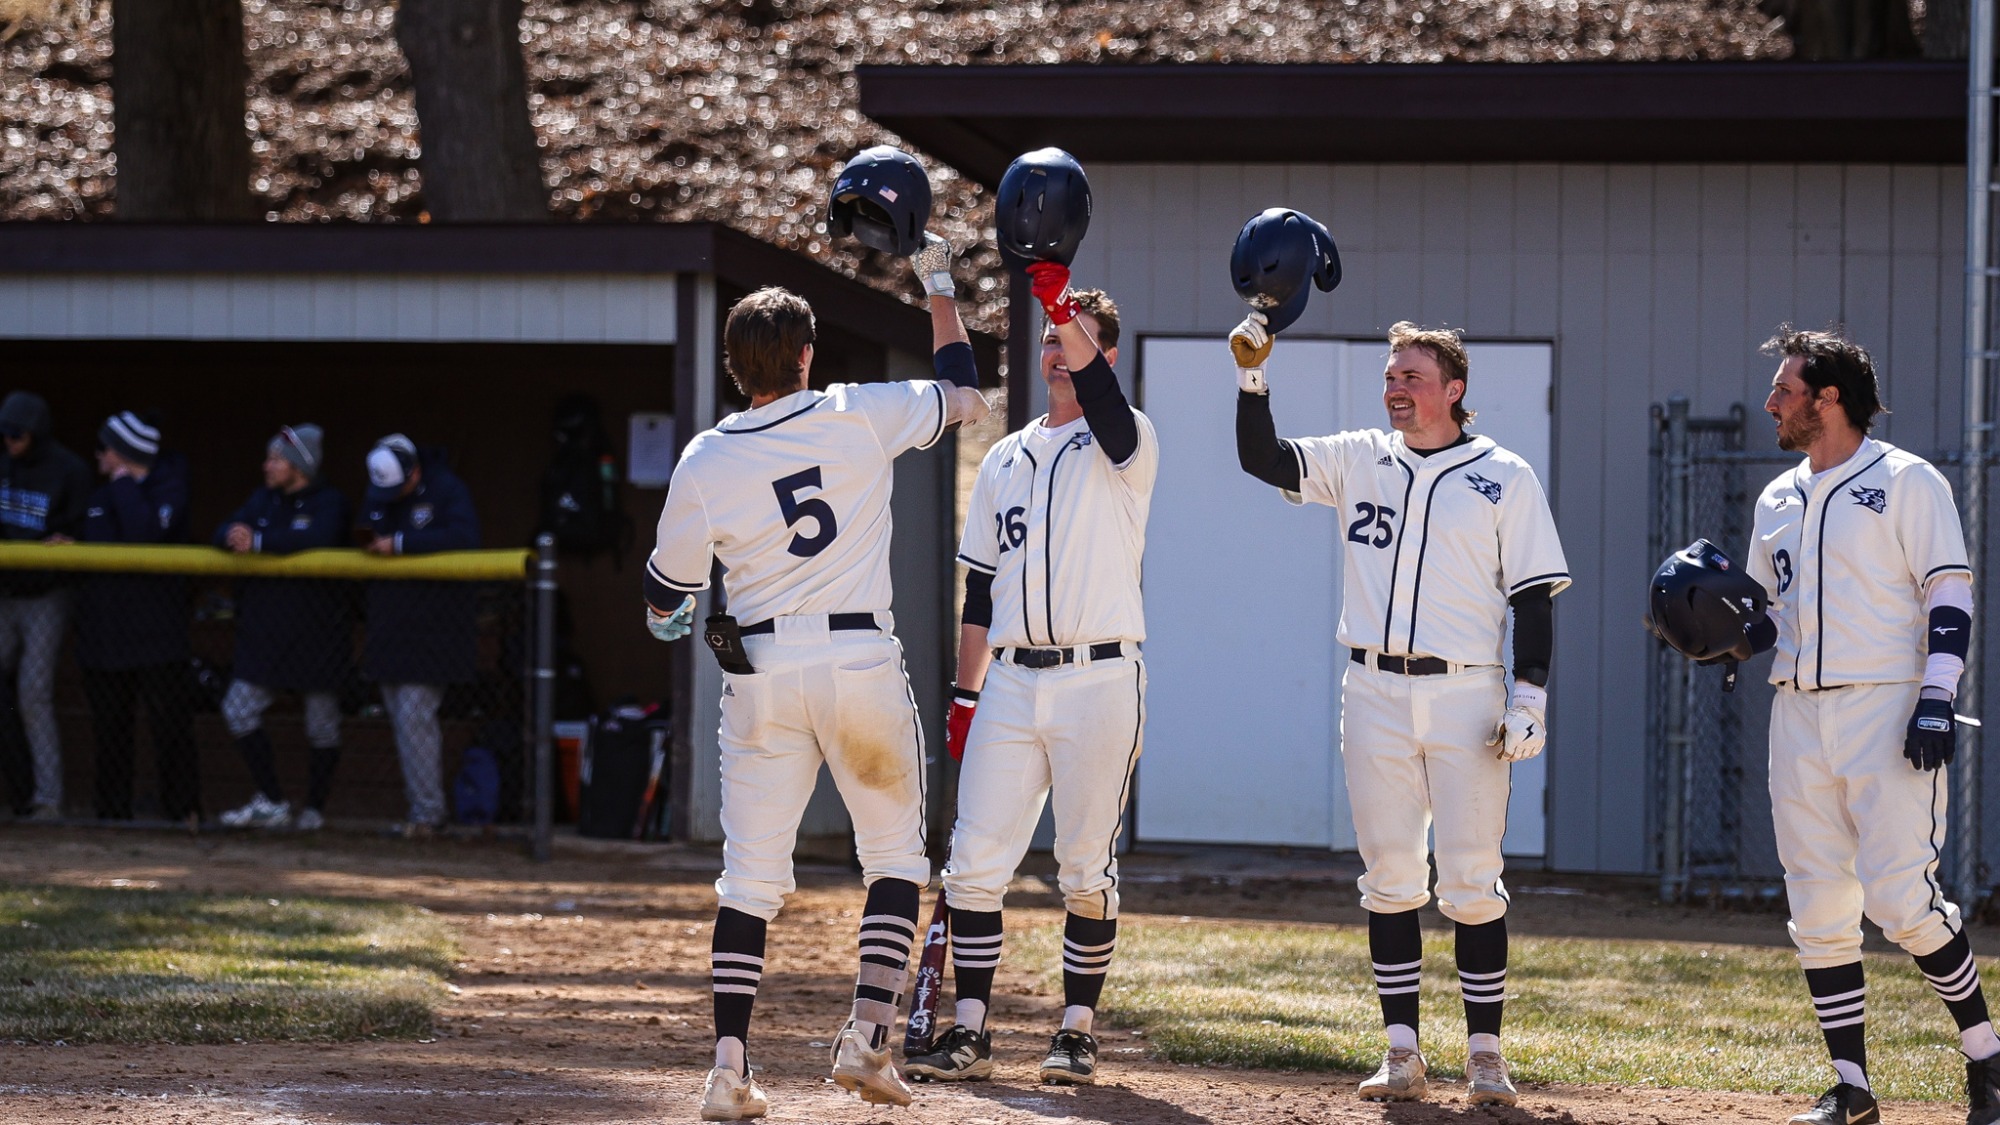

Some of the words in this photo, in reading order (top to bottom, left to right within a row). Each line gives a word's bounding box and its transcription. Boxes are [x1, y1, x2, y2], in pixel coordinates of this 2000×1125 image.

[771, 465, 838, 557] 5
[995, 506, 1027, 555] 26
[1347, 501, 1397, 549] 25
